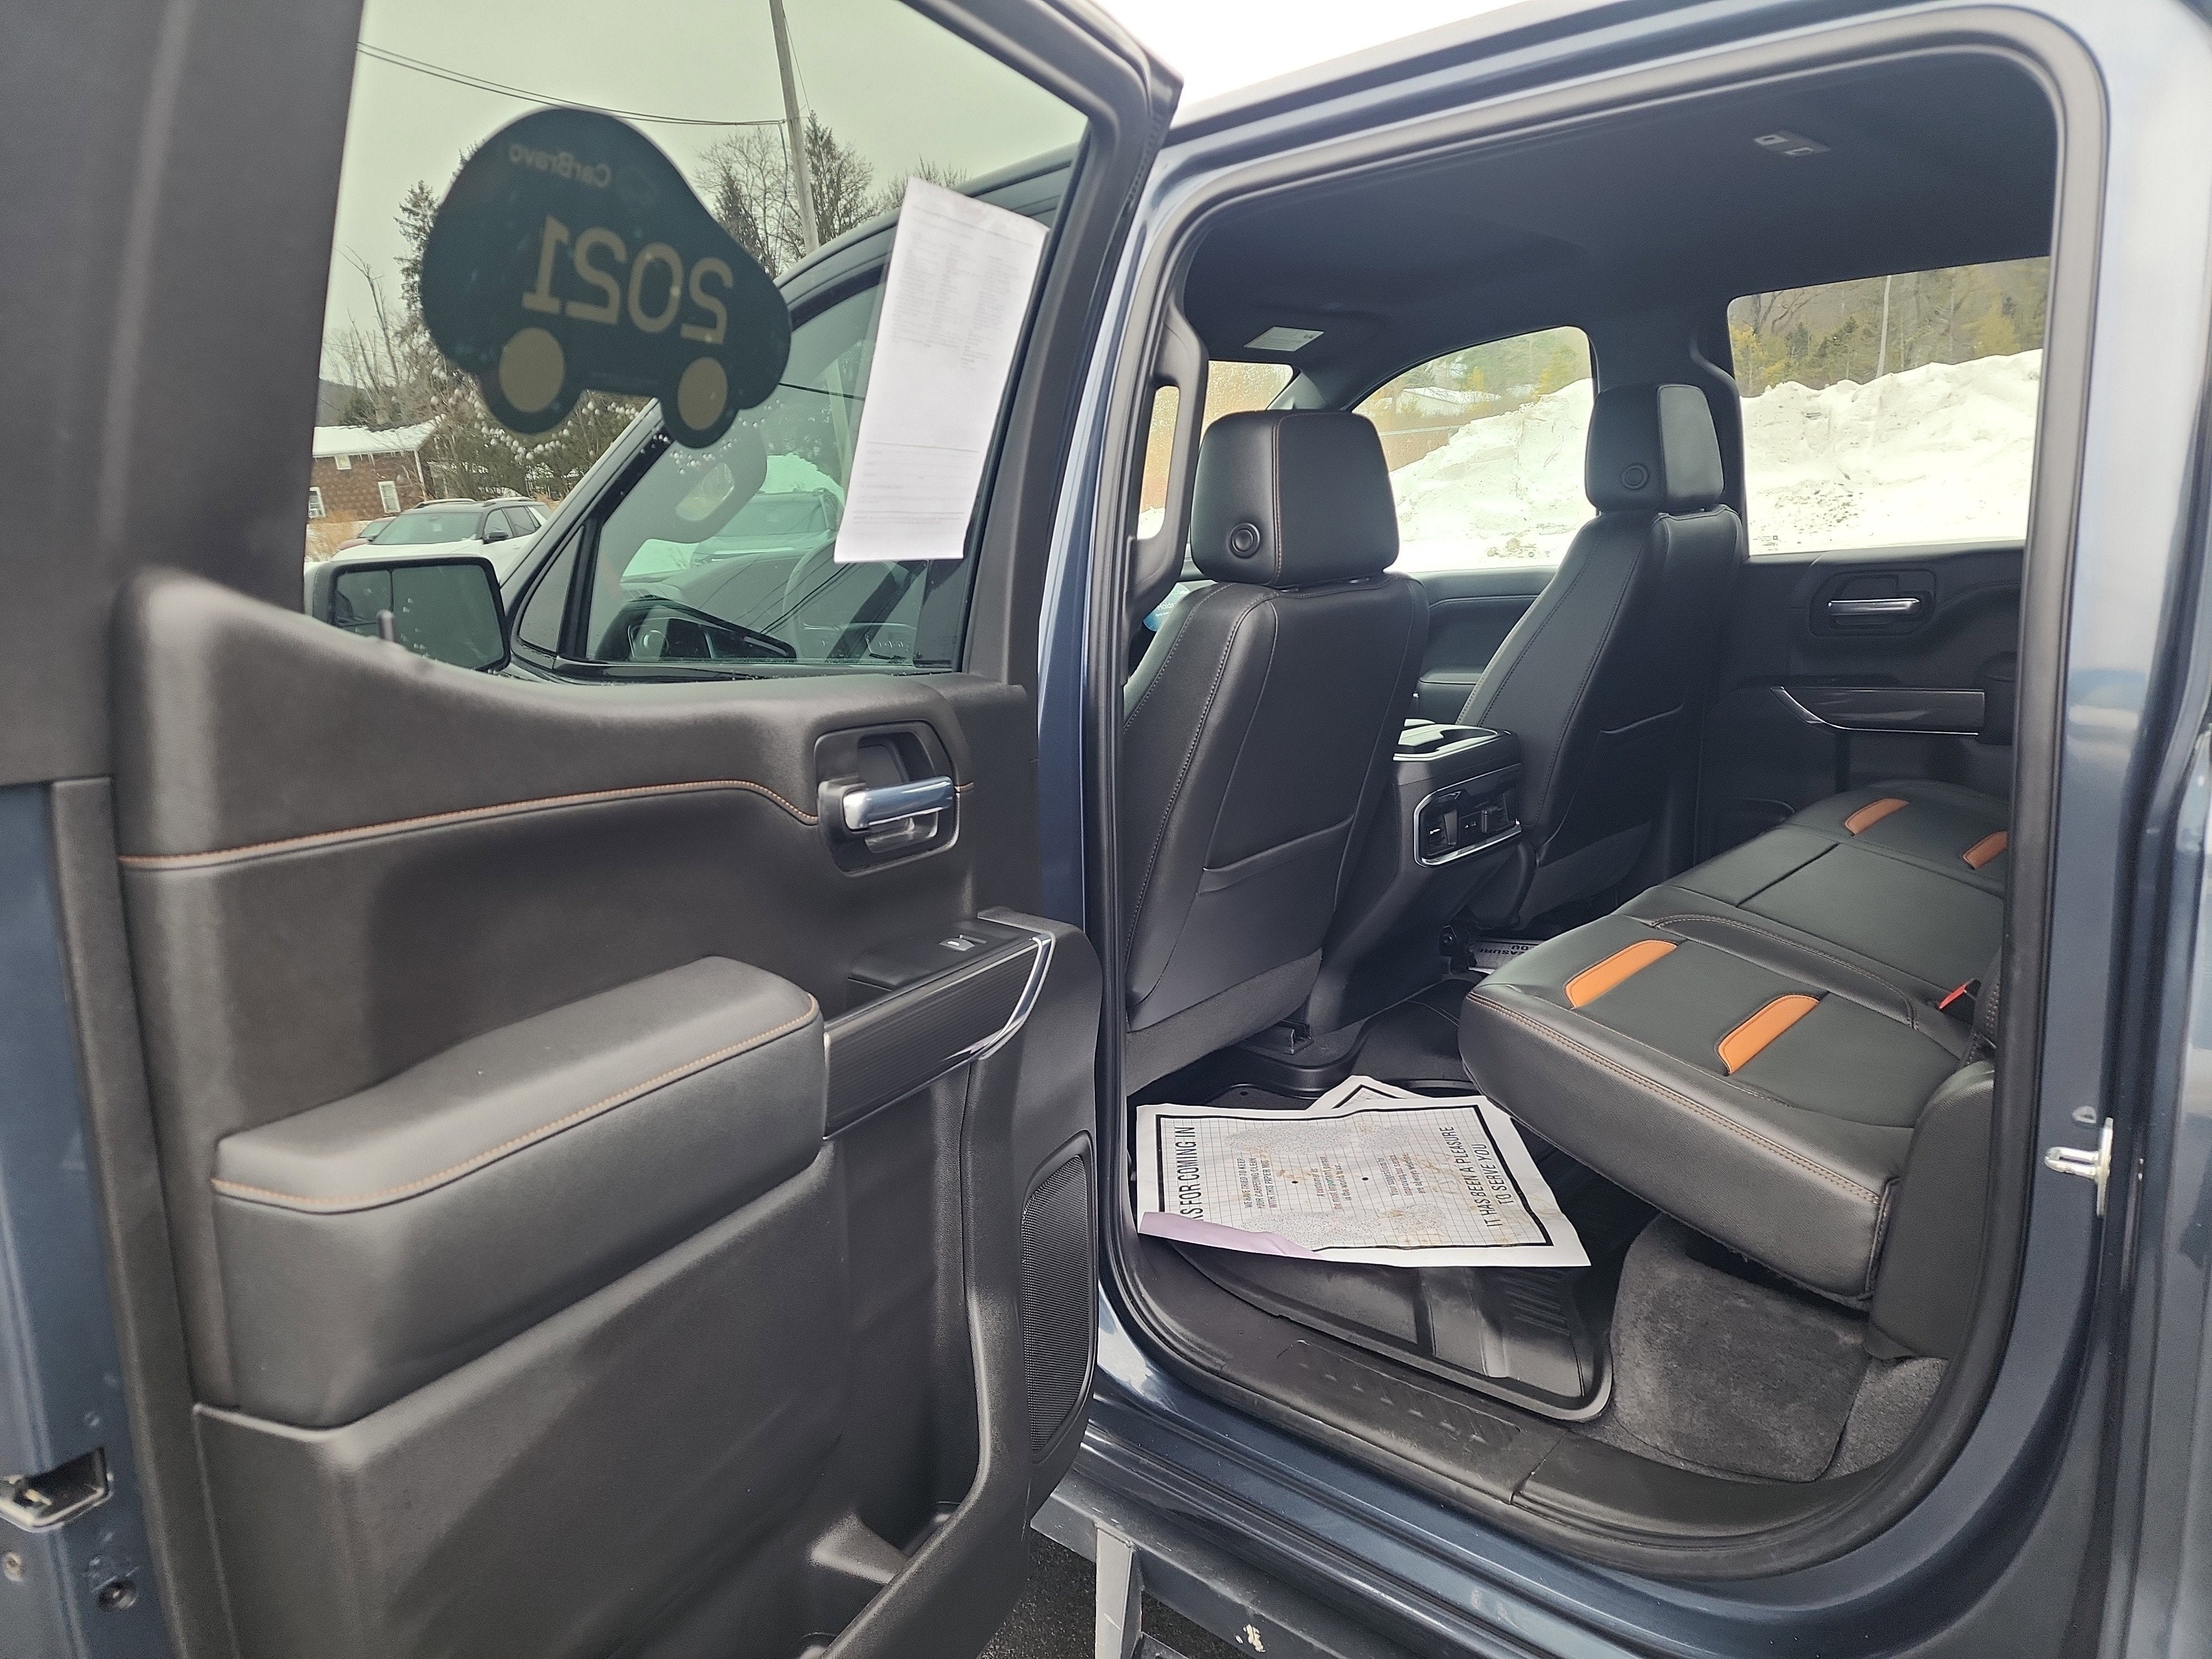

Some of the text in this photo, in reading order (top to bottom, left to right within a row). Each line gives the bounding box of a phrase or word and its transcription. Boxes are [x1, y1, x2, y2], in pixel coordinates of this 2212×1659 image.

[1175, 1127, 1195, 1137] IN
[1439, 1127, 1471, 1164] PLEASURE
[1175, 1142, 1199, 1181] COMING
[1237, 1159, 1245, 1169] KEEP
[1262, 1170, 1273, 1184] PAPER
[1323, 1170, 1337, 1191] important
[1337, 1175, 1348, 1188] world
[1380, 1162, 1395, 1185] suggestions
[1410, 1170, 1423, 1186] always
[1472, 1143, 1514, 1204] TO SERVE YOU
[1240, 1177, 1249, 1189] TRIED
[1249, 1158, 1265, 1208] YOUR CARPETING CLEAN
[1265, 1185, 1275, 1195] THIS
[1313, 1173, 1324, 1193] customer
[1390, 1186, 1399, 1196] Your
[1399, 1174, 1412, 1196] improving
[1463, 1175, 1486, 1197] BEEN
[1178, 1184, 1202, 1205] FOR
[1242, 1190, 1251, 1201] HAVE
[1267, 1197, 1277, 1208] WITH
[1329, 1192, 1339, 1202] most
[1474, 1199, 1497, 1215] HAS
